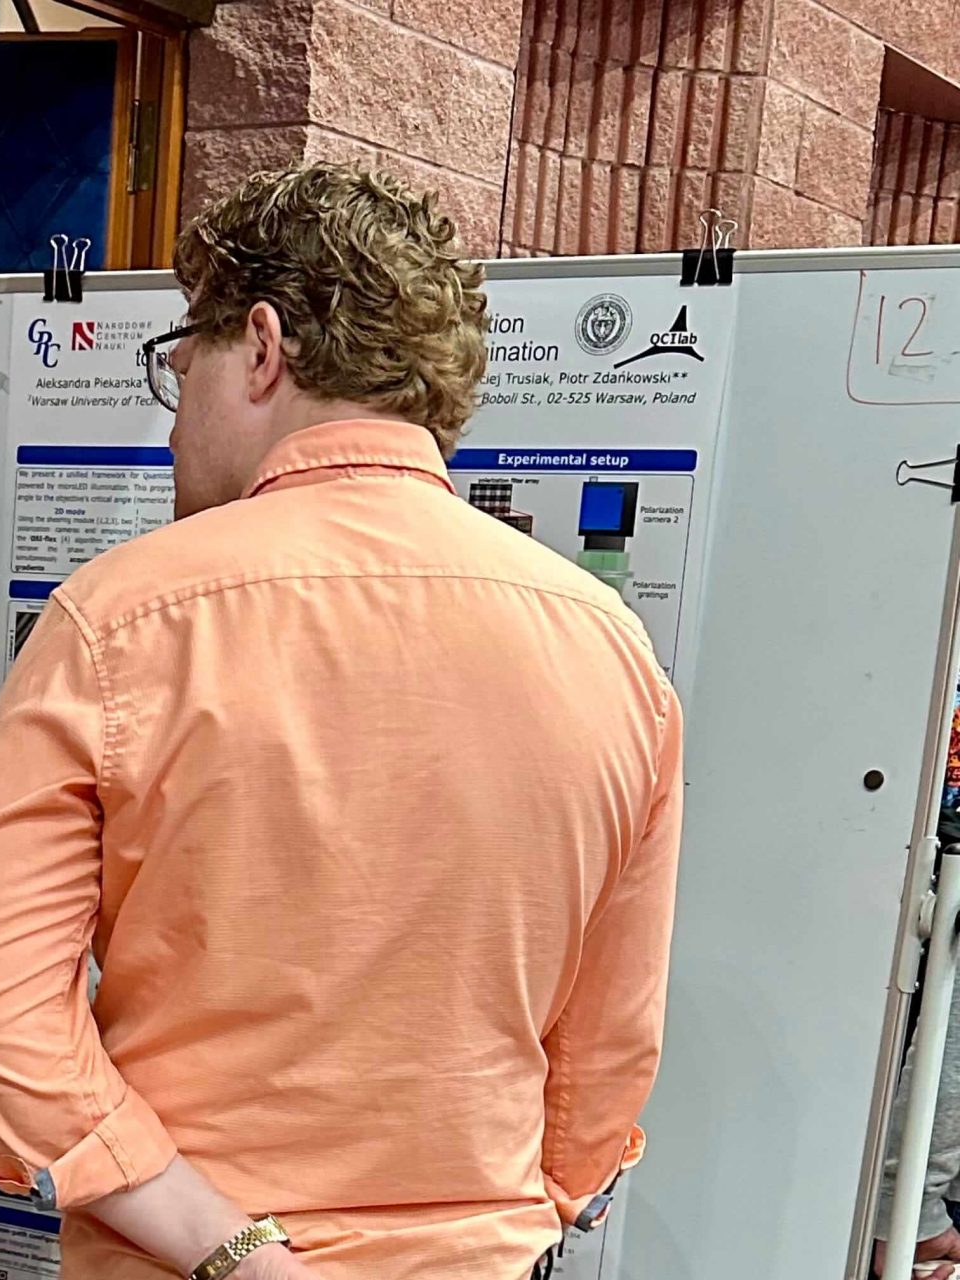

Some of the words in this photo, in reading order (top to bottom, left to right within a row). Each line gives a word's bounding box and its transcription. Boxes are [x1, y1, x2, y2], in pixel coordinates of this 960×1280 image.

[875, 295, 934, 365] 12
[489, 340, 559, 361] ination
[36, 377, 91, 389] Aleksandra
[505, 372, 554, 387] Trusiak,
[559, 371, 589, 384] Piotr
[71, 395, 118, 408] University
[121, 394, 132, 407] of
[546, 391, 592, 405] 02-525
[595, 391, 647, 405] Warsaw,
[652, 391, 697, 404] Poland
[498, 453, 587, 468] Experimental
[590, 454, 629, 468] setup
[640, 506, 684, 515] Polarization
[643, 516, 671, 524] camera
[632, 581, 676, 590] Polarization
